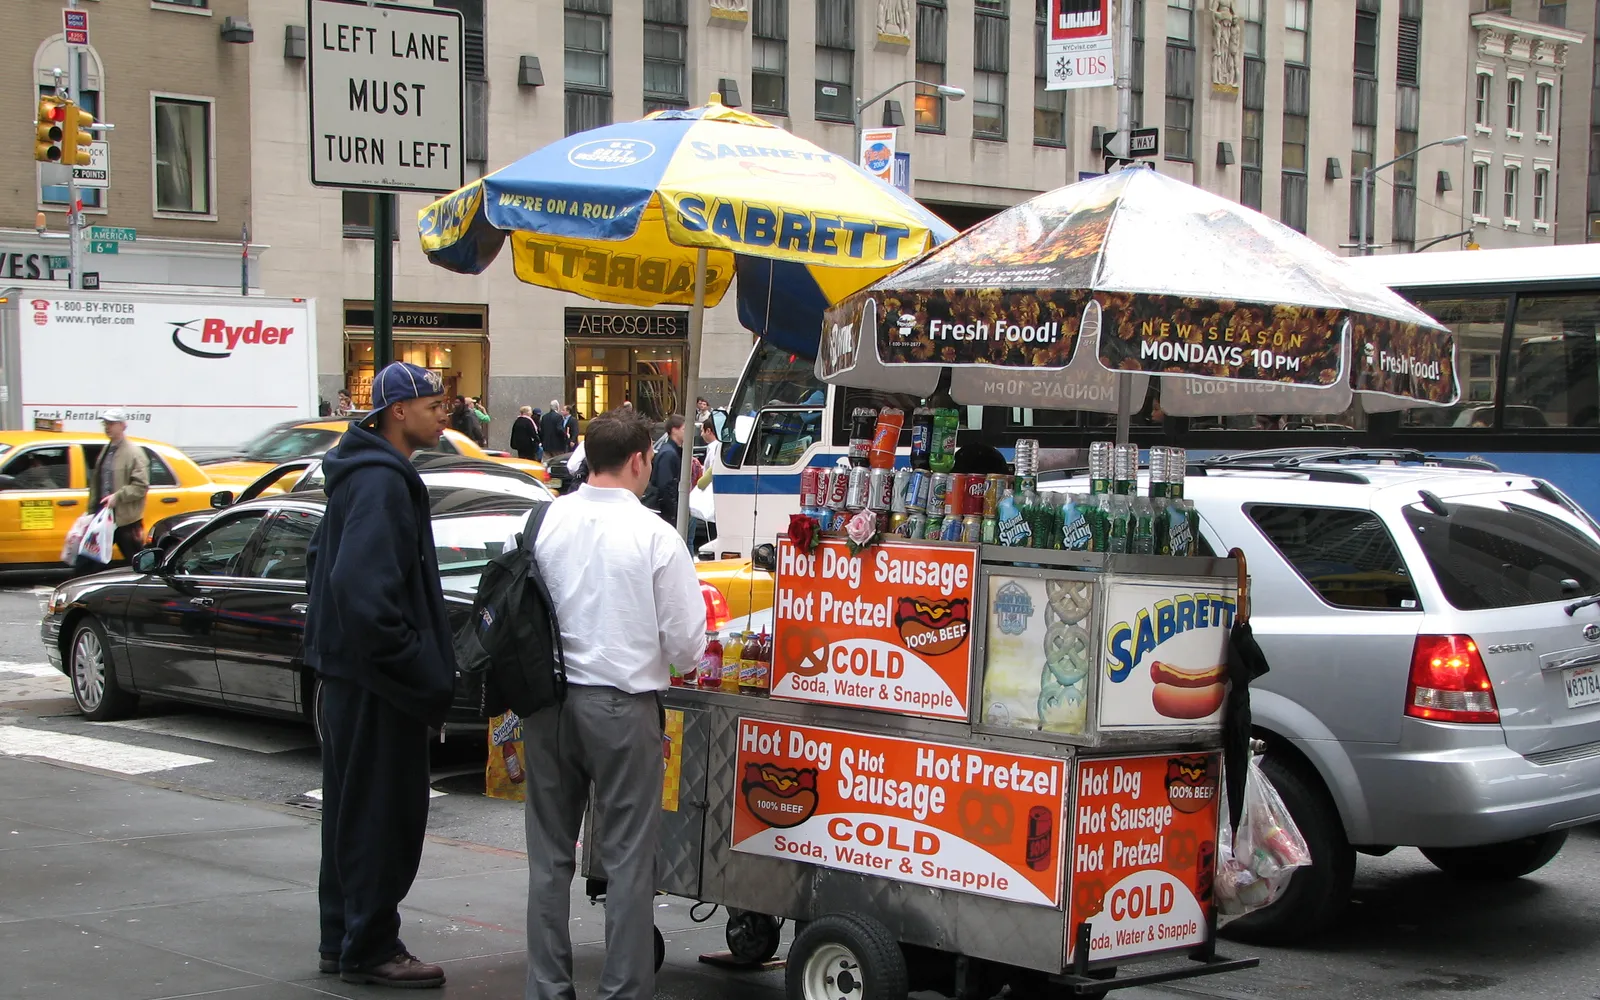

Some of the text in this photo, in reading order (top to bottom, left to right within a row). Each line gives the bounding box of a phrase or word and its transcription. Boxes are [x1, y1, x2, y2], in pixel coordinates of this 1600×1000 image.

[323, 22, 450, 62] LEFT LANE
[1062, 43, 1098, 51] NYCvisit.com
[1076, 56, 1107, 76] UBS
[349, 77, 426, 117] MUST
[324, 134, 451, 170] TURN LEFT
[690, 140, 834, 164] SABRETT
[1136, 136, 1154, 149] WAY
[81, 171, 105, 179] POINTS
[499, 193, 542, 212] WE'RE
[546, 199, 567, 215] ON
[569, 201, 578, 216] A
[583, 202, 615, 219] ROLL
[94, 232, 134, 241] AMERICAS
[673, 191, 911, 261] SABRETT
[96, 243, 104, 253] 6
[55, 301, 135, 314] 1-800-BY-RYDER
[55, 314, 135, 326] www.ryder.com
[392, 314, 439, 325] PAPYRUS
[201, 318, 294, 350] Ryder
[578, 314, 677, 335] AEROSOLES
[929, 319, 1057, 344] Fresh Food!
[1141, 321, 1302, 348] NEW SEASON
[1140, 340, 1243, 367] MONDAYS
[1380, 350, 1440, 381] Fresh Food!
[65, 410, 100, 421] Rental
[831, 473, 848, 503] Coke
[998, 512, 1023, 532] Poland
[999, 521, 1032, 547] Spring
[780, 544, 968, 595] Hot Dog Sausage
[778, 588, 893, 628] Hot Pretzel
[905, 623, 967, 649] 100% BEEF
[1106, 593, 1237, 683] SABRETT
[1488, 642, 1535, 654] SORENTO
[832, 645, 905, 680] COLD
[791, 675, 953, 709] Soda, Water & Snapple
[492, 713, 519, 743] Snapple
[742, 724, 832, 771] Hot Dog
[858, 749, 885, 774] Hot
[837, 747, 946, 821] Sausage
[916, 747, 1058, 796] Hot Pretzel
[1081, 765, 1141, 800] Hot Dog
[1169, 786, 1215, 799] 100% BEEF
[756, 800, 804, 814] 100% BEEF
[1078, 802, 1173, 835] Hot Sausage
[827, 817, 941, 856] COLD
[774, 835, 1009, 891] Soda, Water & Snapple
[1076, 835, 1164, 873] Hot Pretzel
[1110, 882, 1175, 922] COLD
[1091, 919, 1197, 950] oda, Water & Snapple
